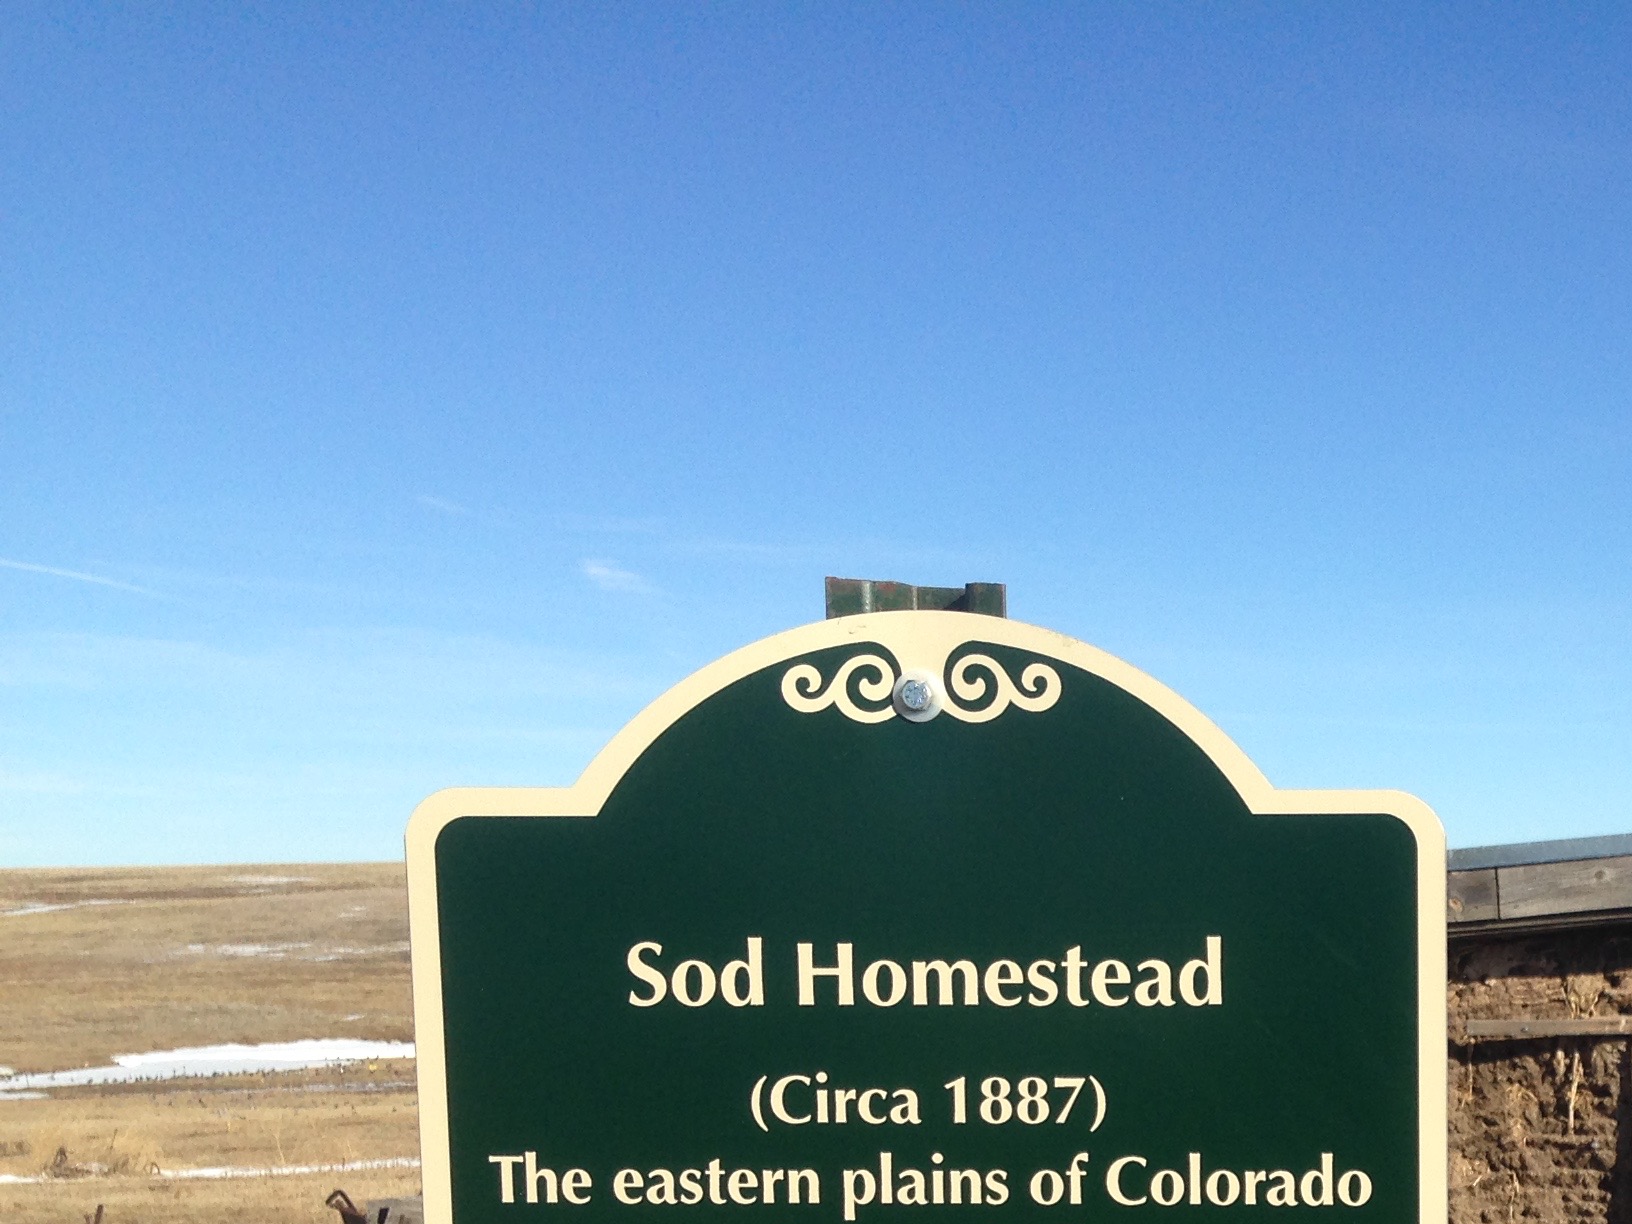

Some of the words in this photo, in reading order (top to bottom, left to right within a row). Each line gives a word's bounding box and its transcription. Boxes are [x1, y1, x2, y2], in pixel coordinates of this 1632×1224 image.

[626, 936, 765, 1007] Sod
[796, 935, 1223, 1007] Homestead
[750, 1071, 922, 1132] (Circa
[944, 1074, 1107, 1133] 1887)
[488, 1150, 593, 1205] The
[612, 1158, 820, 1205] eastern
[842, 1151, 1010, 1222] plains
[1029, 1151, 1089, 1206] of
[1105, 1152, 1373, 1207] Colorado
